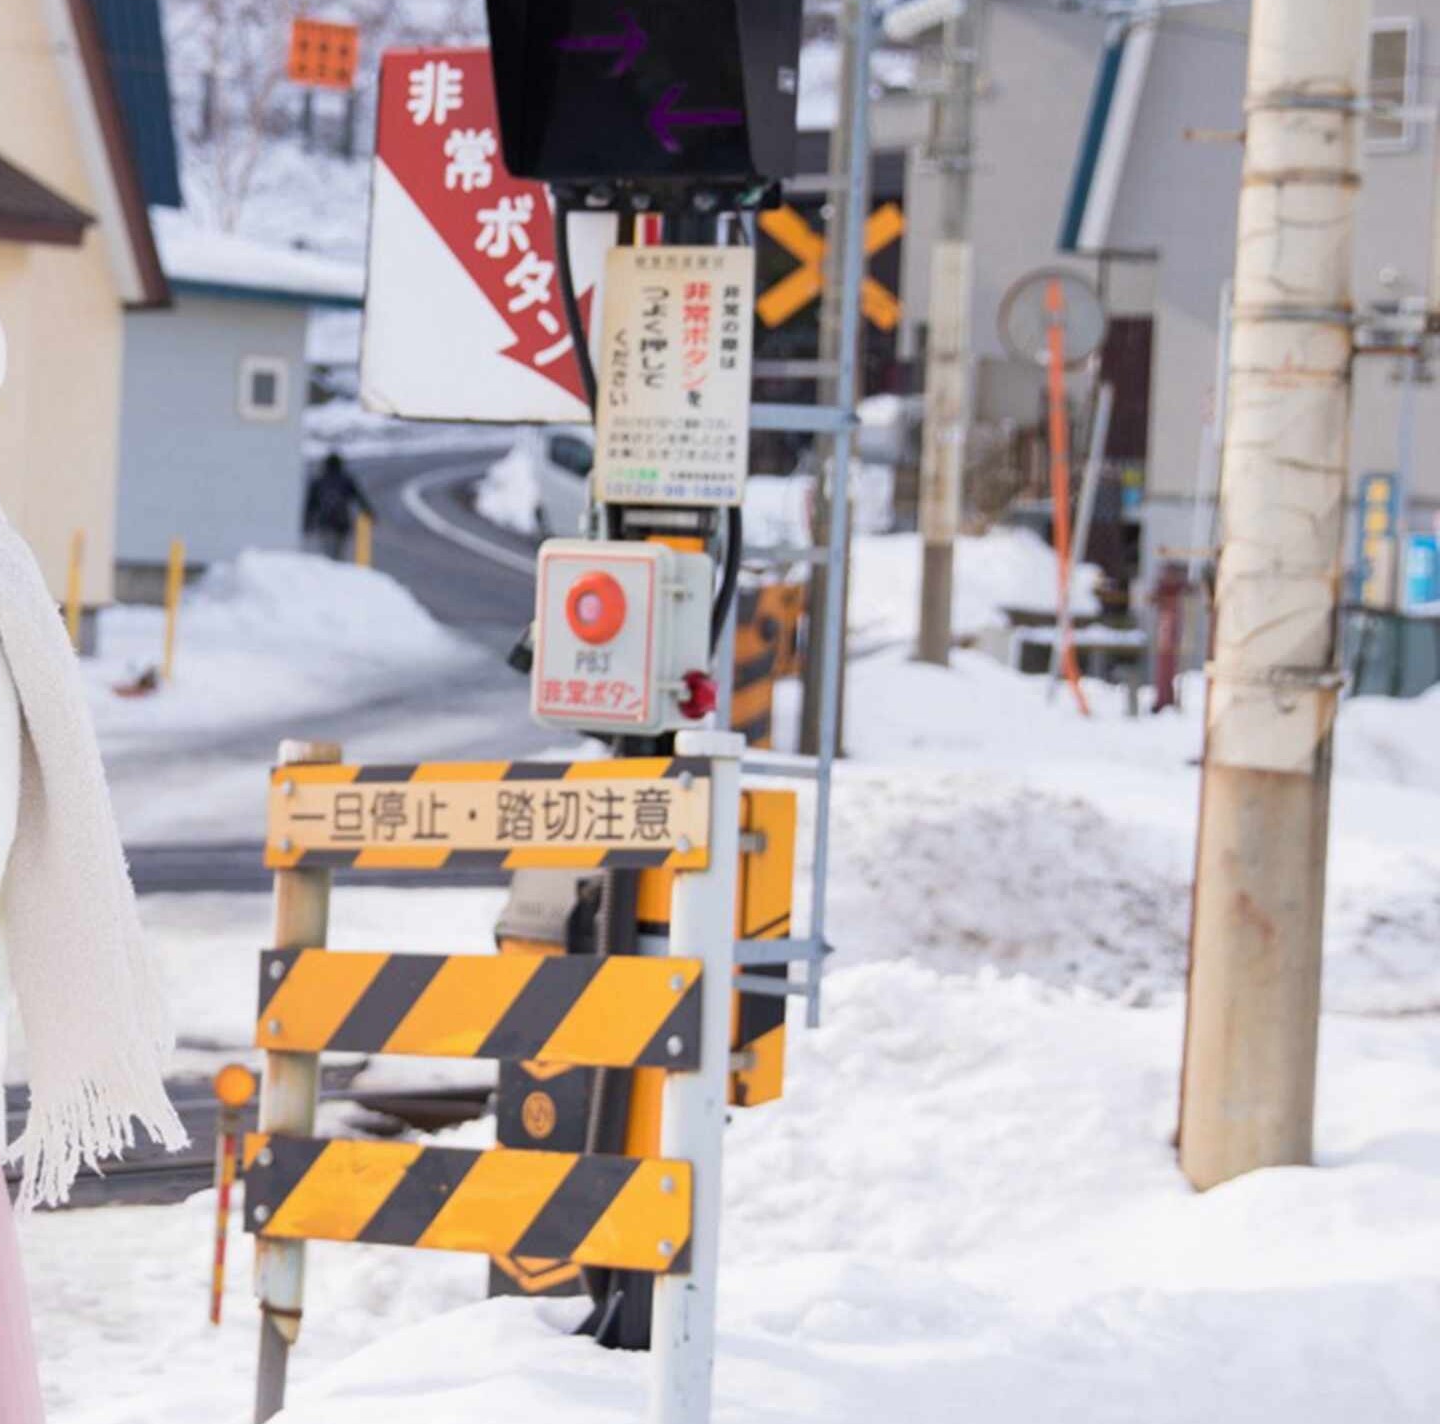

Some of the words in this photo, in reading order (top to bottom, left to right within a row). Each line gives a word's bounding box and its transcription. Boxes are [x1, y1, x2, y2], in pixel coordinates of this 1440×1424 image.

[406, 60, 574, 367] 非常ボタン
[290, 787, 674, 841] 一旦停止・踏切注意
